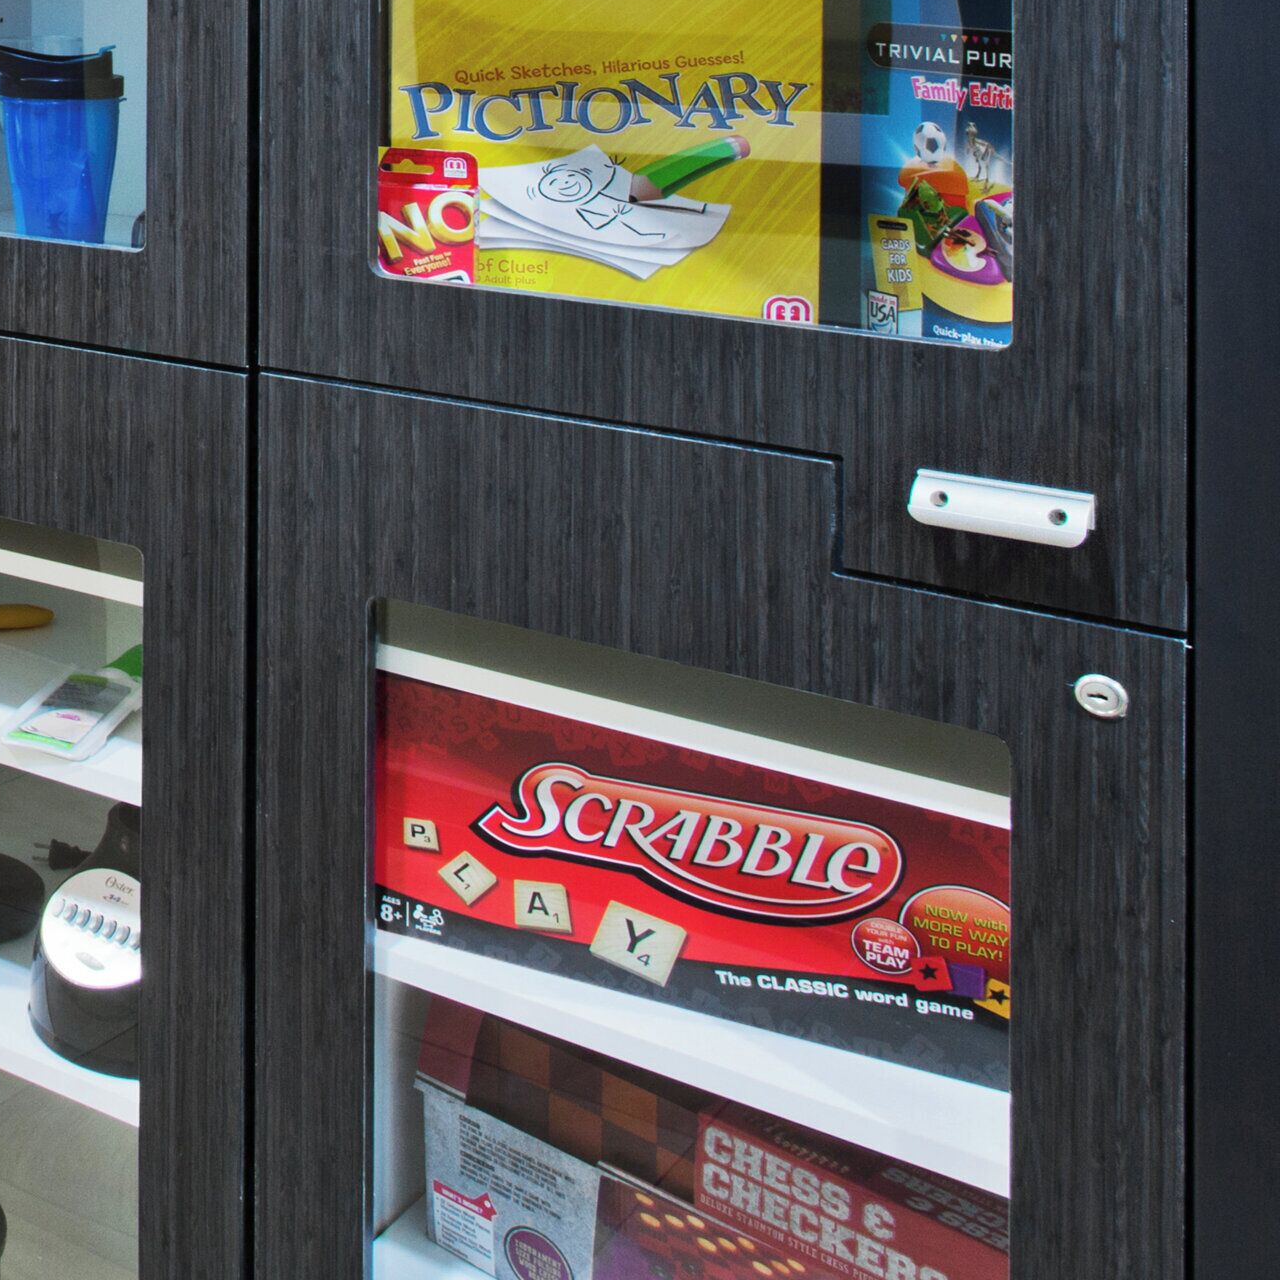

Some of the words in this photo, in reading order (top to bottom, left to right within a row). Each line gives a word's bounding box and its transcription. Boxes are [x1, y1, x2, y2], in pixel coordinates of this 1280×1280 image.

[875, 42, 960, 64] TRIVIAL
[966, 50, 1013, 69] PUR
[455, 68, 505, 85] Quick
[510, 63, 597, 81] Sketches,
[602, 58, 670, 75] Hilarious
[675, 50, 745, 69] Guesses!
[911, 76, 968, 111] Family
[399, 71, 810, 141] PICTIONARY
[880, 239, 912, 251] CARDS
[404, 258, 452, 276] Everyone!
[498, 259, 549, 275] Clues!
[889, 253, 907, 265] FOR
[484, 275, 512, 285] Adult
[515, 277, 536, 289] plus
[887, 269, 912, 283] KIDS
[870, 301, 896, 323] USA
[410, 823, 425, 838] P
[502, 772, 881, 904] SCRABBLE
[453, 862, 470, 883] L
[105, 876, 133, 894] Oster
[380, 903, 402, 922] 8+
[525, 891, 550, 918] A
[925, 903, 969, 923] NOW
[973, 916, 1008, 932] with
[623, 918, 656, 955] Y
[913, 916, 962, 937] MORE
[968, 928, 1009, 947] WAY
[862, 939, 909, 959] TEAM
[928, 934, 950, 949] TO
[956, 941, 1003, 962] PLAY!
[637, 951, 650, 968] 4
[865, 951, 907, 970] PLAY
[715, 971, 752, 991] The
[757, 974, 848, 1000] CLASSIC
[854, 987, 909, 1008] word
[915, 998, 975, 1020] game
[703, 1125, 851, 1221] CHESS
[700, 1194, 733, 1217] DELUXE
[789, 1236, 817, 1258] STYLE
[820, 1253, 849, 1274] CHESS
